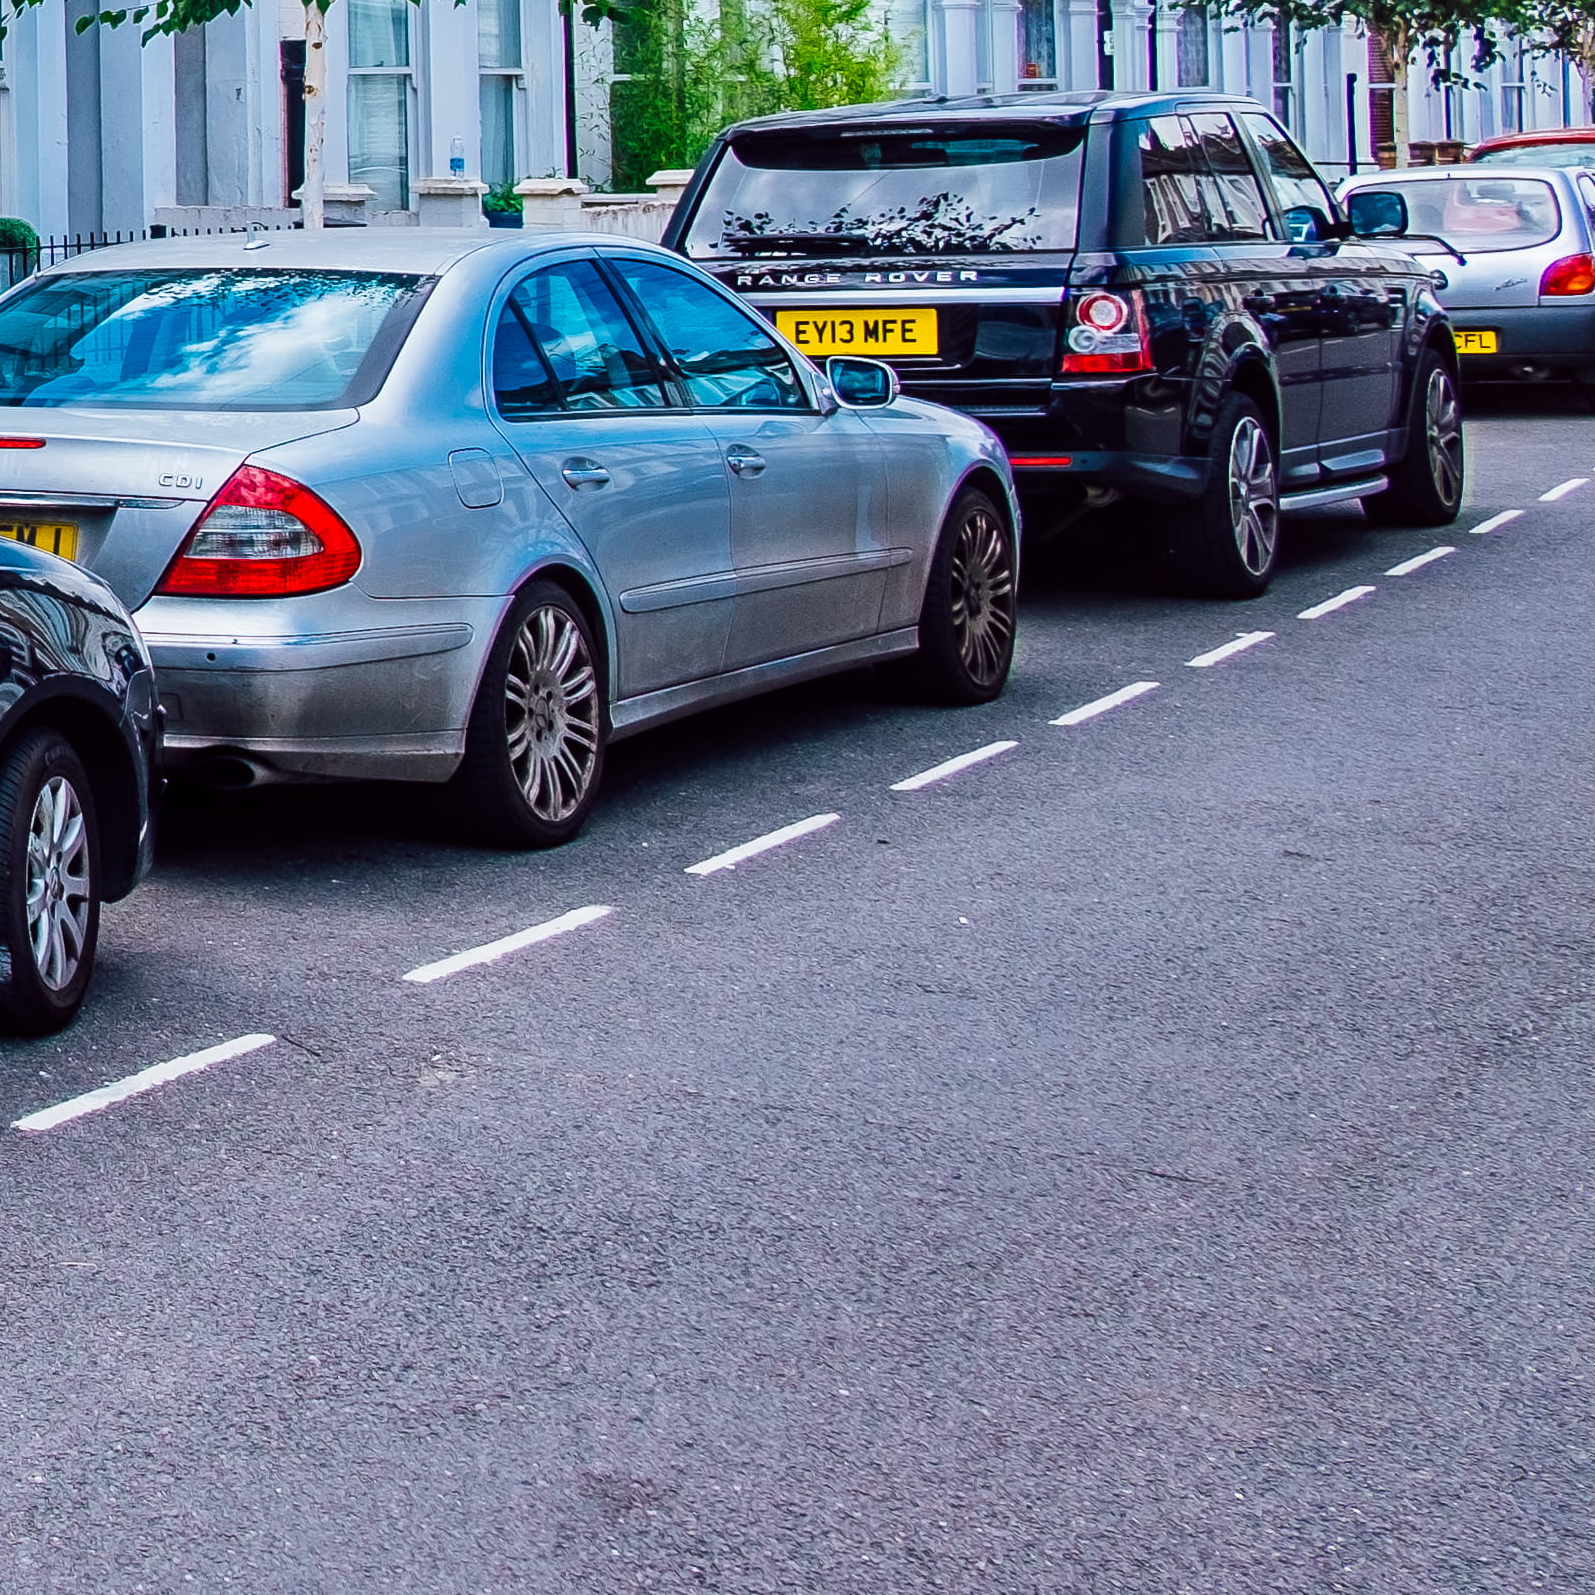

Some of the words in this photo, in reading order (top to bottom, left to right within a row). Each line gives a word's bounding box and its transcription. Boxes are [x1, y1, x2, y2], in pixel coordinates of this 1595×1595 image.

[736, 273, 842, 286] RANGE
[864, 270, 979, 283] ROVER
[794, 319, 855, 344] EY13
[863, 318, 917, 343] MFE
[158, 474, 203, 490] CDI
